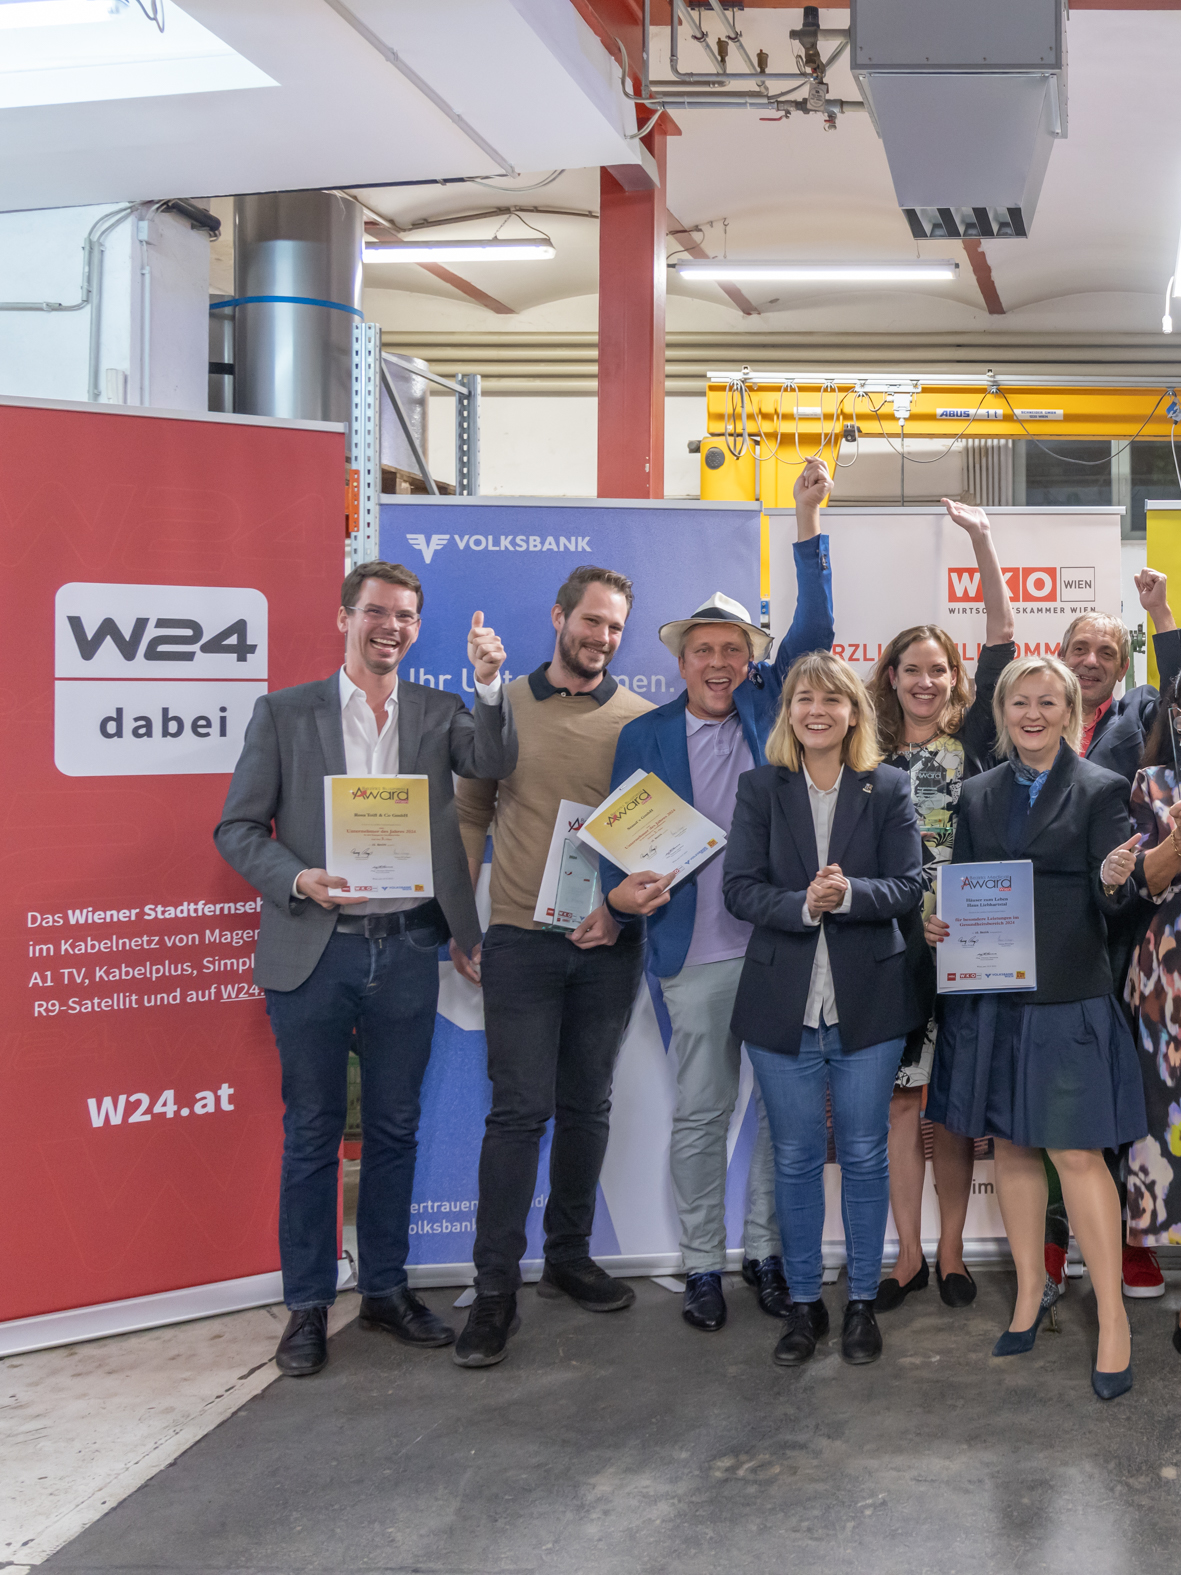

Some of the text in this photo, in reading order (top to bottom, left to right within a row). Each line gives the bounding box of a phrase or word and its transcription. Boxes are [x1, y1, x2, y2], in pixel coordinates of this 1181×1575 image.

[939, 410, 998, 419] ABUS 1 t
[454, 535, 592, 552] VOLKSBANK
[1064, 580, 1092, 589] WIEN
[948, 607, 1065, 615] WIRTSCSKAMMER
[66, 615, 258, 662] W24
[410, 668, 452, 691] Ihr
[99, 706, 227, 739] dabei
[352, 787, 409, 800] Award
[608, 789, 651, 827] Award
[961, 876, 1011, 890] Award
[27, 911, 63, 927] Das
[68, 907, 139, 925] Wiener
[29, 941, 54, 957] im
[60, 935, 159, 955] Kabelnetz
[164, 933, 199, 947] von
[29, 971, 54, 987] A1
[60, 968, 90, 986] TV,
[96, 960, 197, 981] Kabelplus,
[34, 996, 139, 1017] R9-Satellit
[144, 988, 181, 1006] und
[186, 984, 217, 1003] auf
[87, 1083, 234, 1128] W24.at
[410, 1200, 479, 1214] ertrauen
[408, 1218, 476, 1235] olksbank
